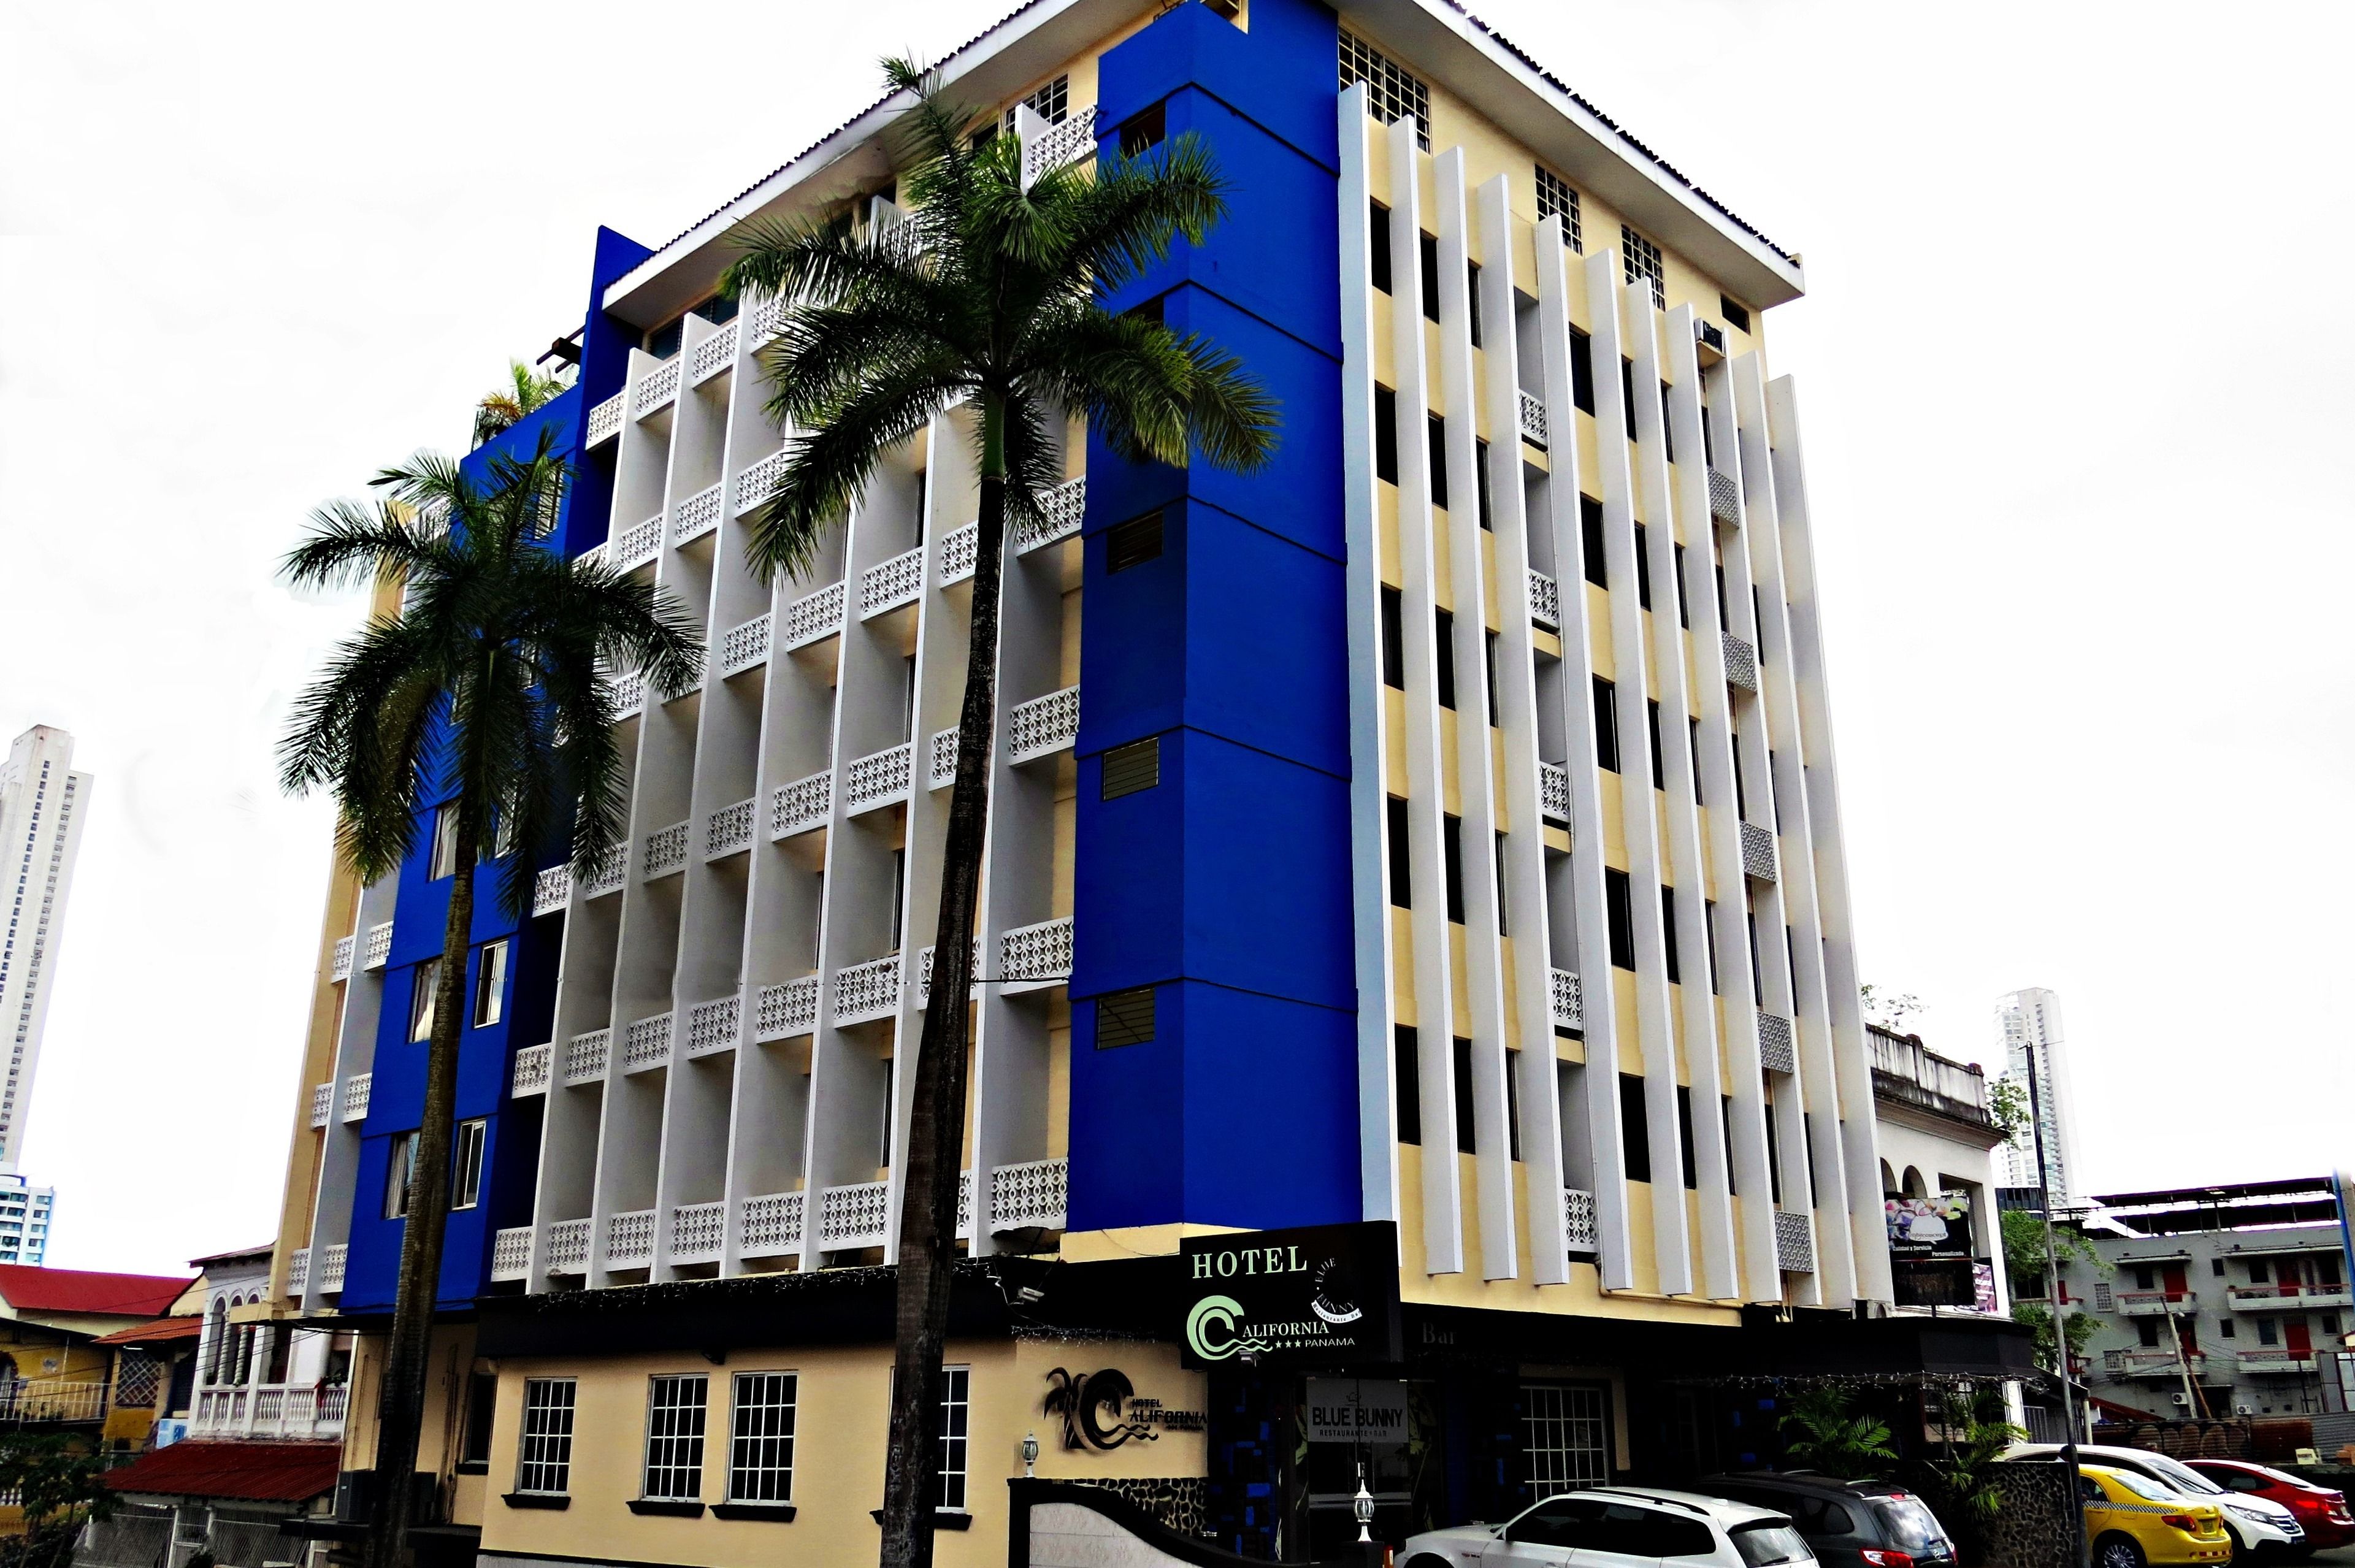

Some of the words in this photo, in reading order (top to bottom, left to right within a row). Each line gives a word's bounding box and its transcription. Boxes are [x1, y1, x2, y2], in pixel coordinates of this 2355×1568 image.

[1192, 1245, 1307, 1279] HOTEL
[1315, 1258, 1336, 1282] BLUE
[1305, 1337, 1355, 1347] PANAMA
[1422, 1322, 1457, 1344] Bar
[1132, 1399, 1163, 1408] HOTEL
[1312, 1407, 1351, 1426] BLUE
[1355, 1408, 1403, 1428] BUNNY
